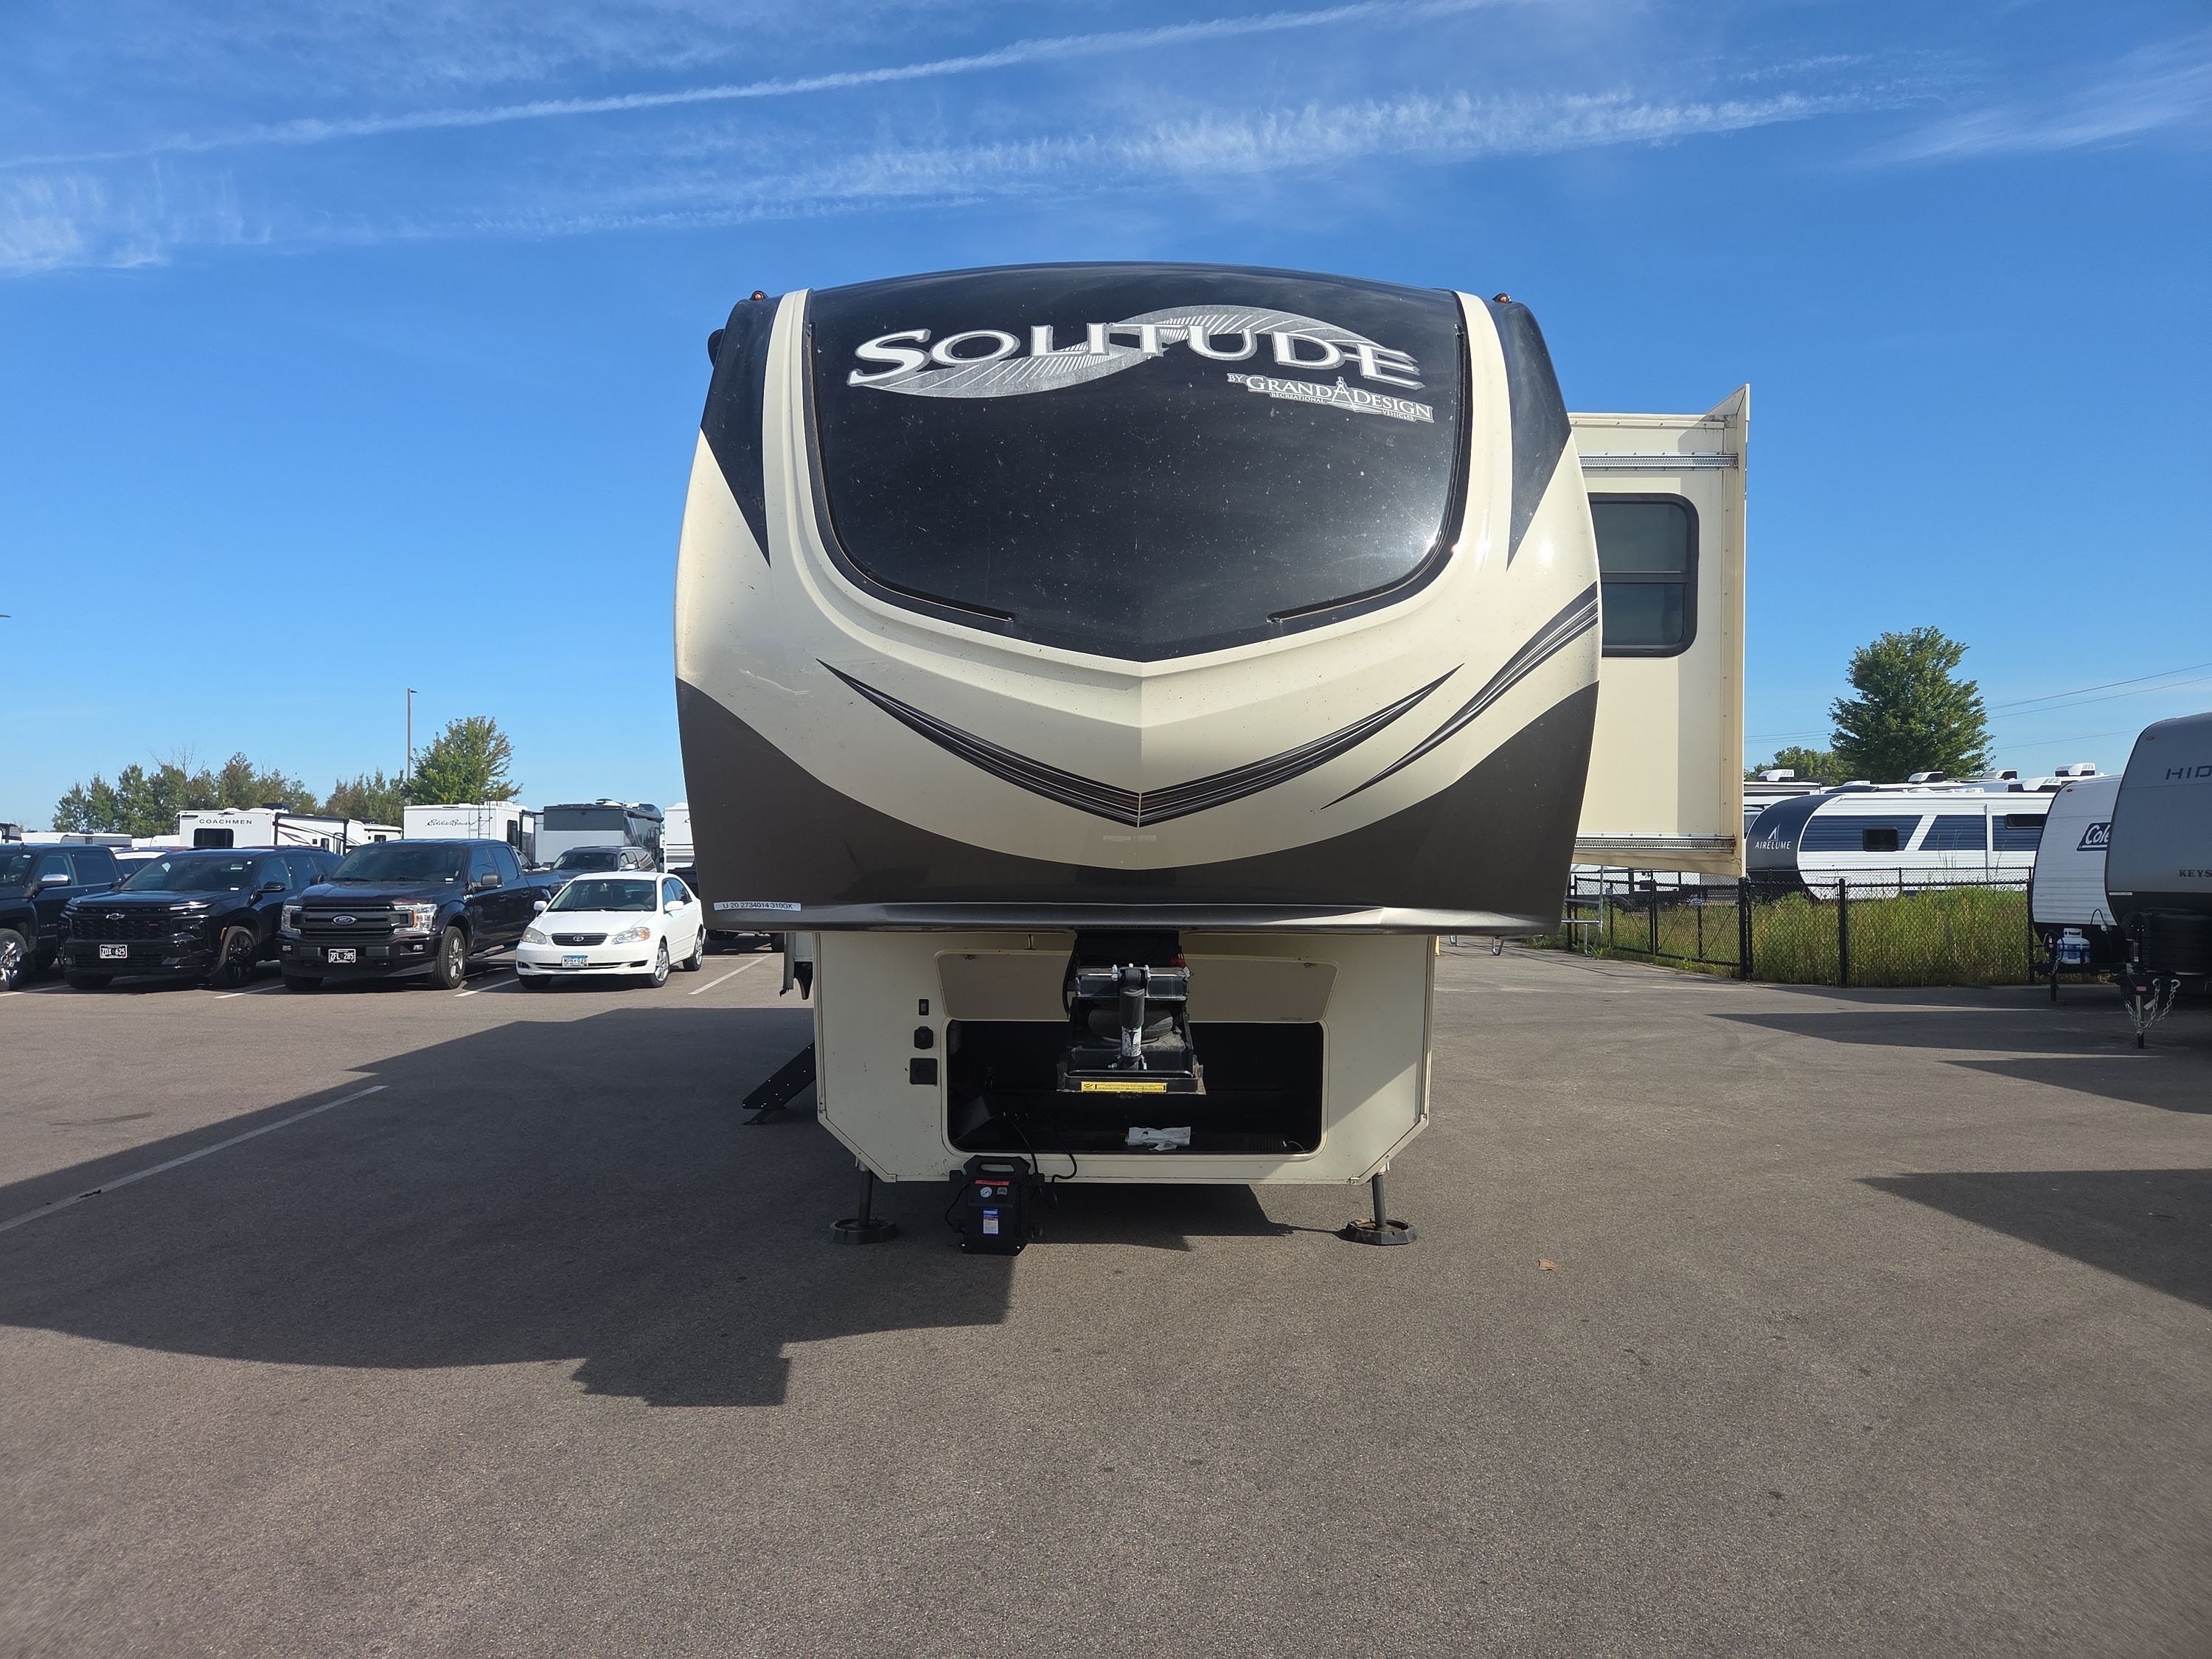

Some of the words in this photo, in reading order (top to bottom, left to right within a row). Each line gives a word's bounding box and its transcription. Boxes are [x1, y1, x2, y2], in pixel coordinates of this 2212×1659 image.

[848, 322, 1425, 390] SOLITUDE
[1228, 375, 1243, 383] BY
[1246, 376, 1332, 398] GRAND
[1352, 389, 1431, 419] DESIGN
[1270, 393, 1326, 404] RECREATIONAL
[1382, 409, 1415, 421] VEHICLES
[2165, 765, 2212, 781] HID
[1755, 841, 1791, 849] AIRELUME
[2179, 869, 2212, 877] KEYS
